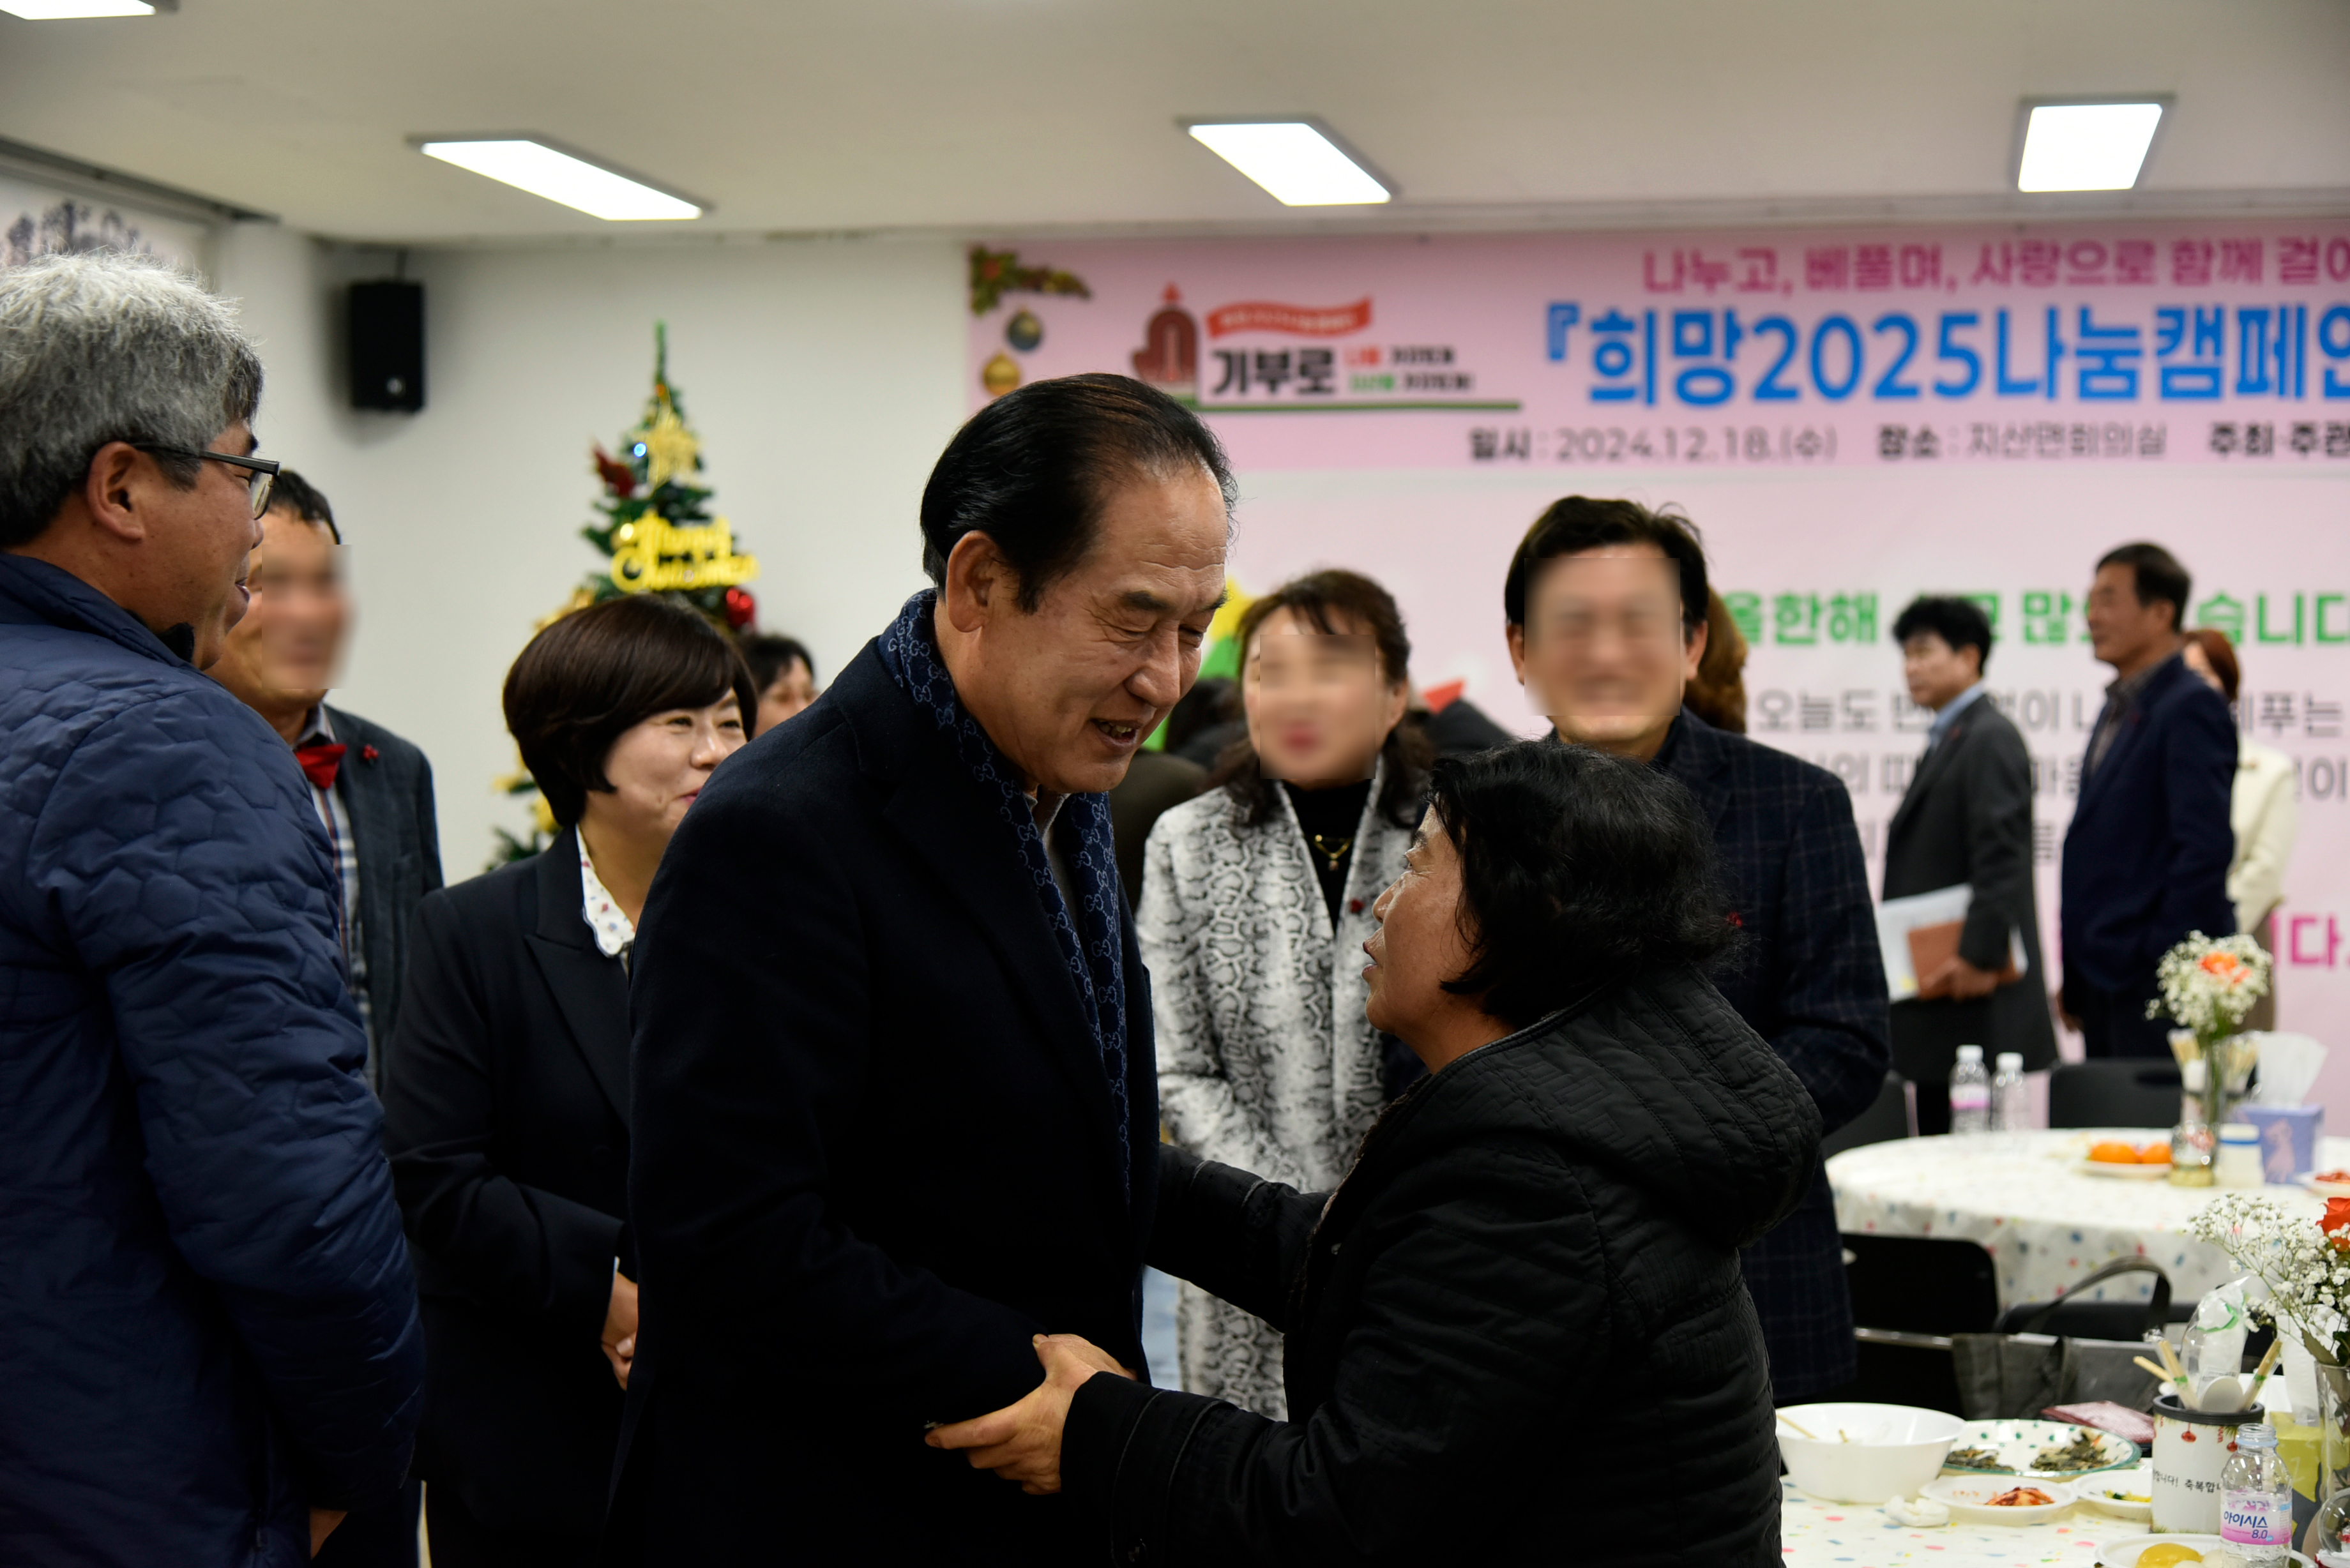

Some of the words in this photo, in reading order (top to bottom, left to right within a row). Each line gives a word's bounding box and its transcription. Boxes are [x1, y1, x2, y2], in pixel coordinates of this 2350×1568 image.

[1642, 245, 1793, 296] 나누고,
[1805, 245, 1957, 294] 베풀며,
[1972, 240, 2157, 289] 사랑으로
[2172, 236, 2264, 287] 함께
[1211, 349, 1335, 396] 기부로
[1470, 426, 1531, 461] 일시
[1880, 425, 1940, 461] 장소
[1755, 688, 1880, 733] 오늘도
[2224, 1511, 2268, 1528] 아이시스
[2252, 1529, 2268, 1539] 8.0
